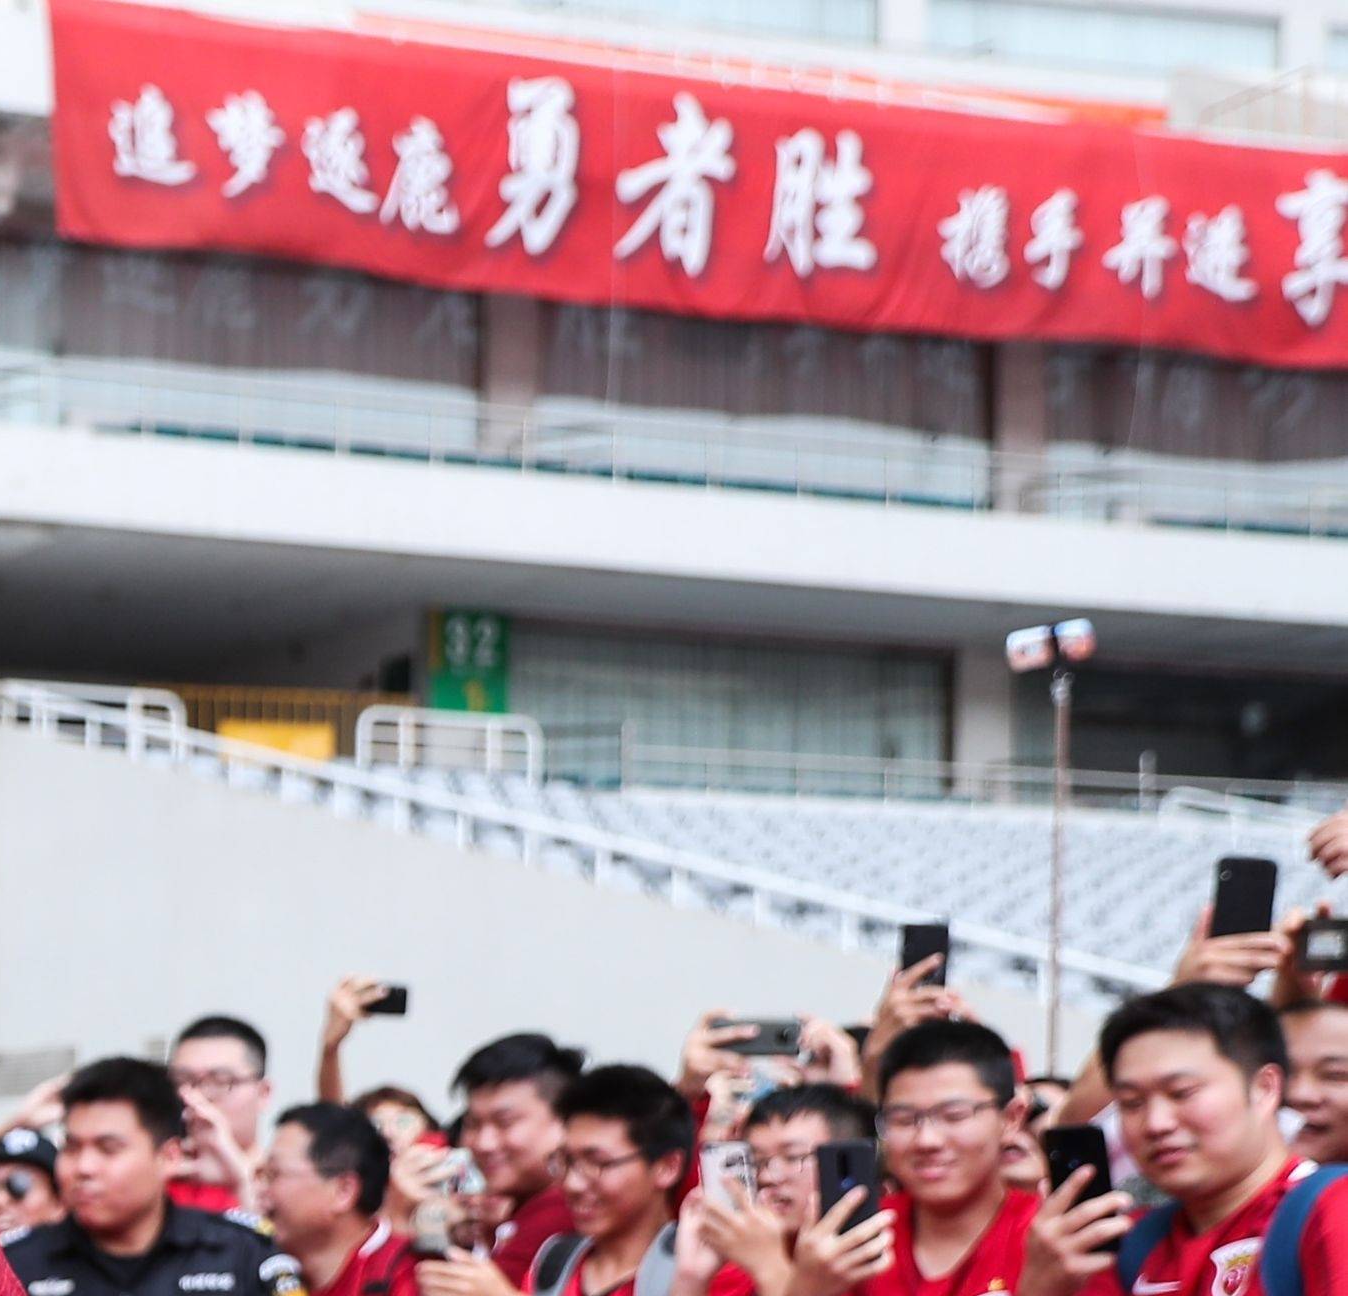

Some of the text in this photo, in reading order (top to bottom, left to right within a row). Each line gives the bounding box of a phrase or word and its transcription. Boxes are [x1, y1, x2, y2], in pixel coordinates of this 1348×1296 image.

[108, 83, 460, 234] 追梦逐鹿
[485, 77, 878, 277] 勇者胜
